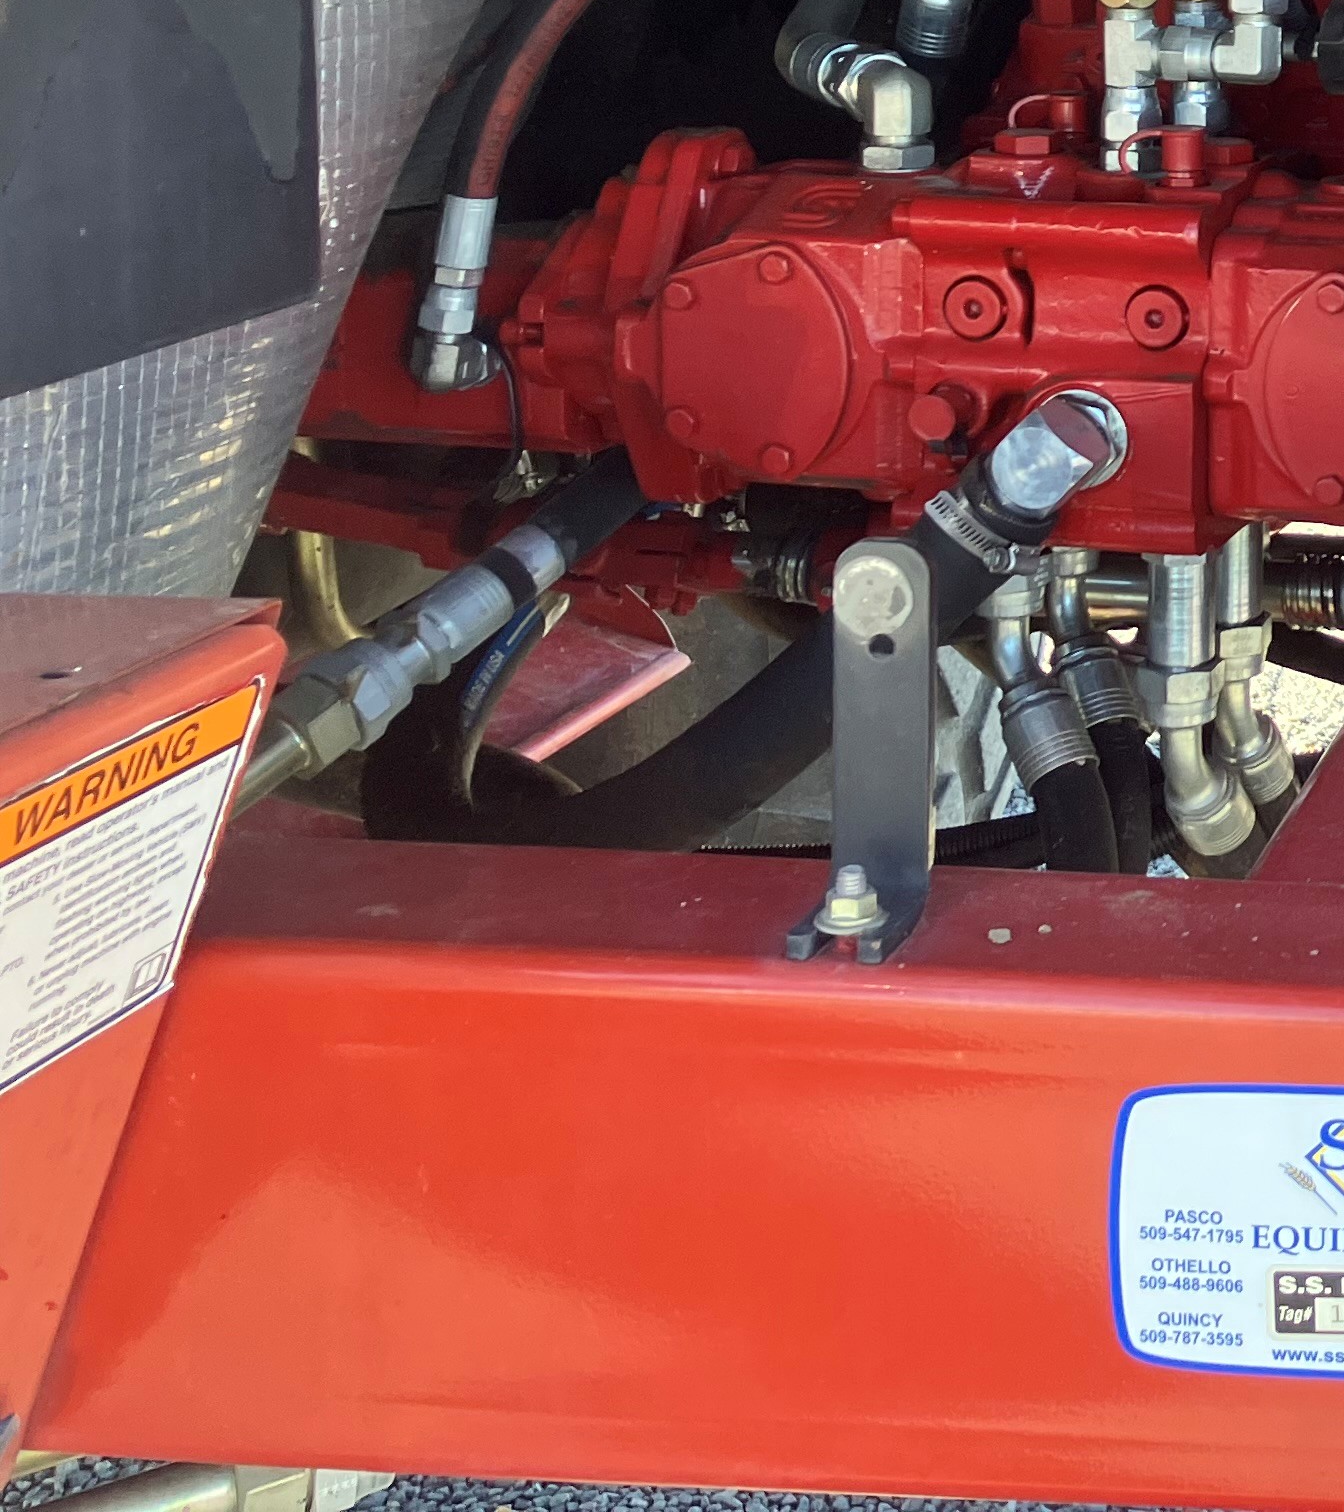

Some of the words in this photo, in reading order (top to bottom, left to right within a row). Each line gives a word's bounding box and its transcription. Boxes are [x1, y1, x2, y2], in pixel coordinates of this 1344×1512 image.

[14, 722, 200, 845] WARNING
[5, 859, 62, 901] SAFETY
[1164, 1209, 1223, 1225] PASCO
[1139, 1225, 1243, 1243] 509-547-1795
[1151, 1257, 1231, 1274] OTHELLO
[1139, 1275, 1243, 1293] 509-488-9606
[1279, 1276, 1332, 1296] S.S.
[1157, 1311, 1223, 1328] QUINCY
[1278, 1305, 1313, 1323] Tag#
[1139, 1328, 1243, 1346] 509-787-3595
